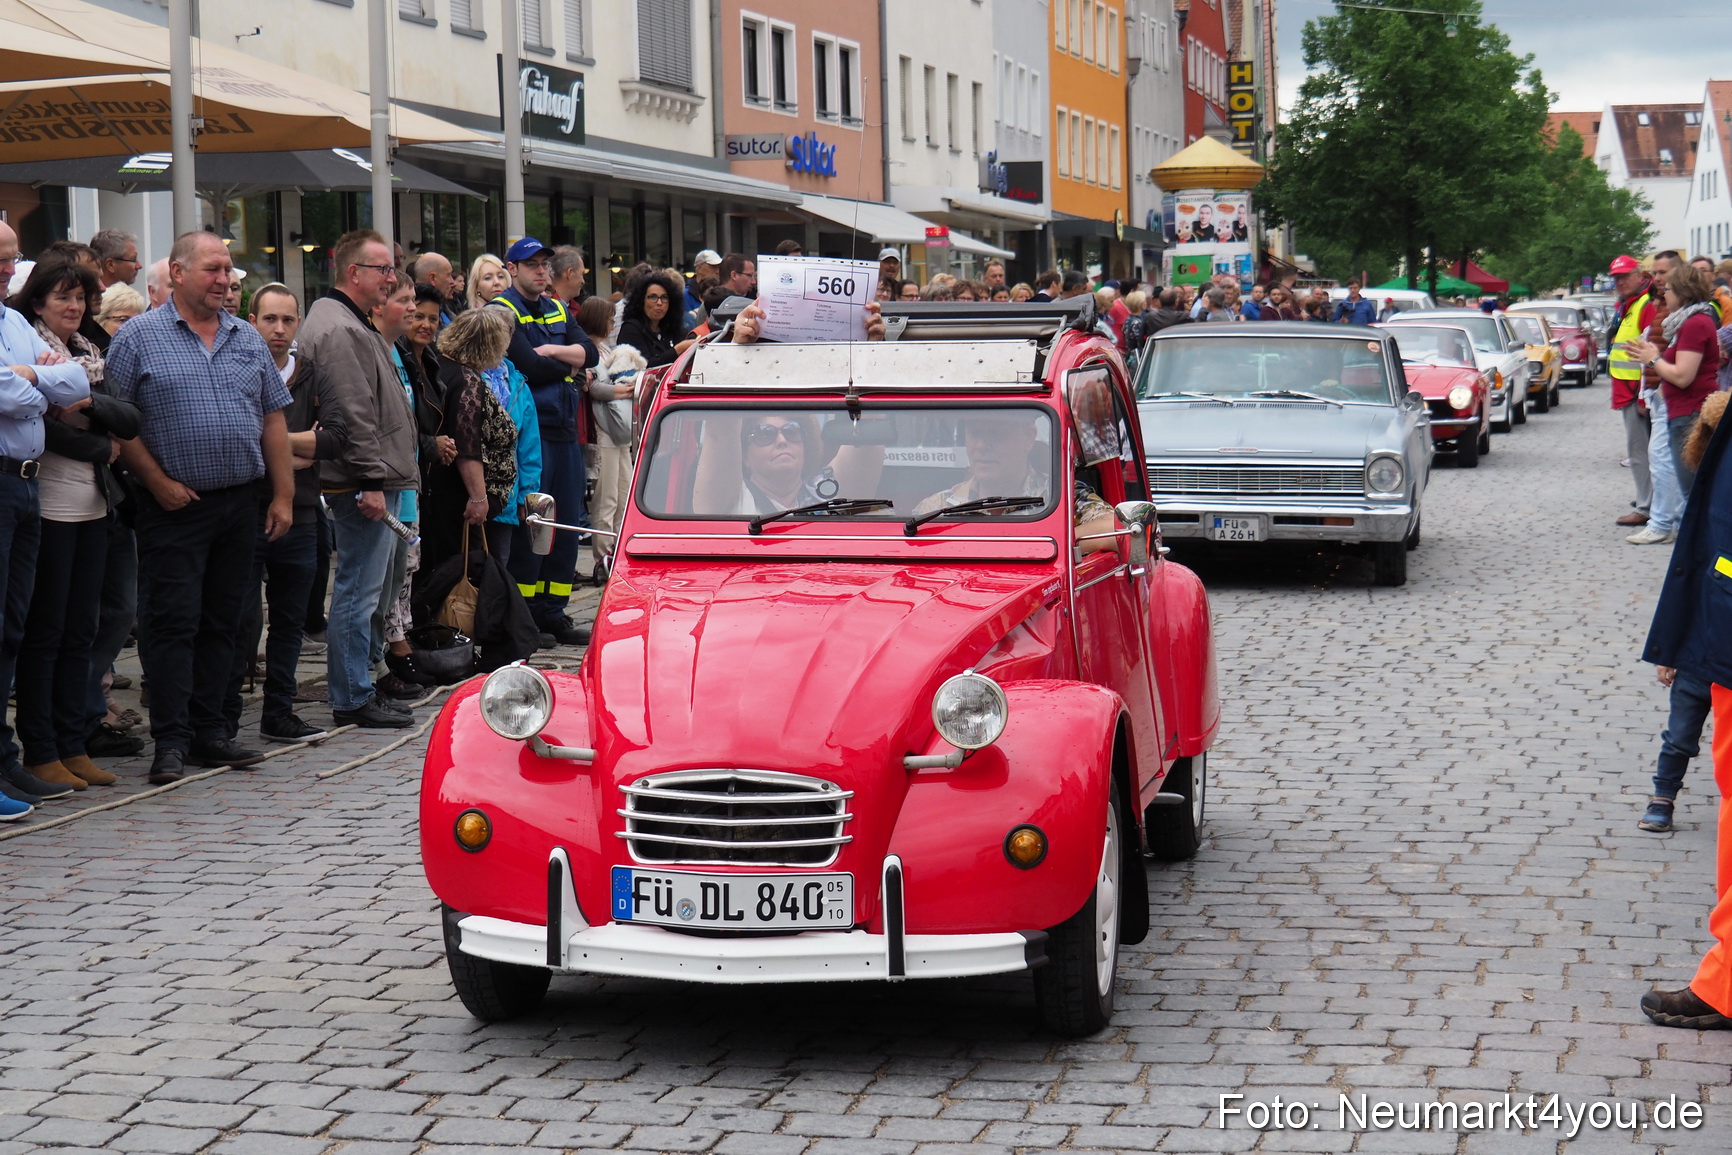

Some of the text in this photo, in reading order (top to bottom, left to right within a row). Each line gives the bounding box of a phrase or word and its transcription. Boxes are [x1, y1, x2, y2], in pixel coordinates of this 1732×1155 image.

[519, 66, 584, 135] frühauf
[1229, 63, 1254, 154] HOT
[817, 276, 856, 297] 560
[1224, 519, 1239, 529] FÜ
[1219, 530, 1255, 540] A 26 H
[827, 881, 844, 892] 05
[618, 898, 627, 910] D
[632, 876, 673, 918] FÜ
[700, 881, 745, 921] DL
[756, 882, 824, 922] 840
[828, 908, 844, 920] 10
